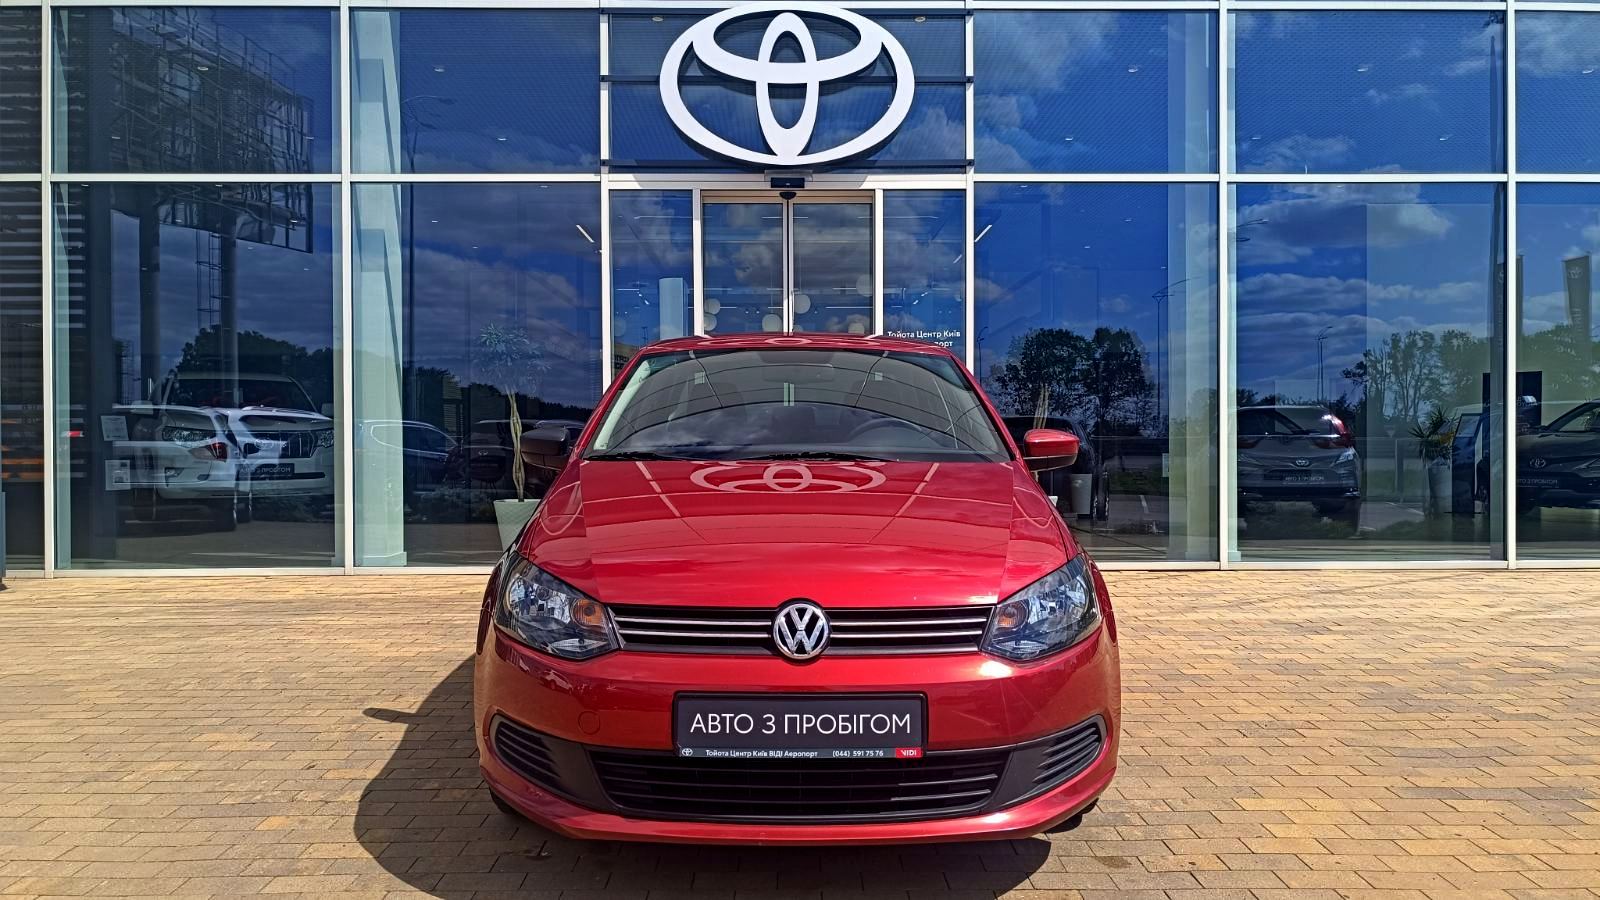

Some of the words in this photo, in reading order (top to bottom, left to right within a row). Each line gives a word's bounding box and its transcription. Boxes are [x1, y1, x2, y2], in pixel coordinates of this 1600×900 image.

[887, 330, 915, 338] Тойота
[916, 330, 942, 339] Центр
[943, 329, 961, 338] Київ
[689, 713, 754, 734] АВТО
[761, 713, 776, 734] З
[784, 713, 911, 734] ПРОБІГОМ
[705, 749, 729, 757] Тойота
[730, 750, 752, 758] Центр
[784, 750, 818, 758] Аеропорт
[832, 750, 851, 758] (044)
